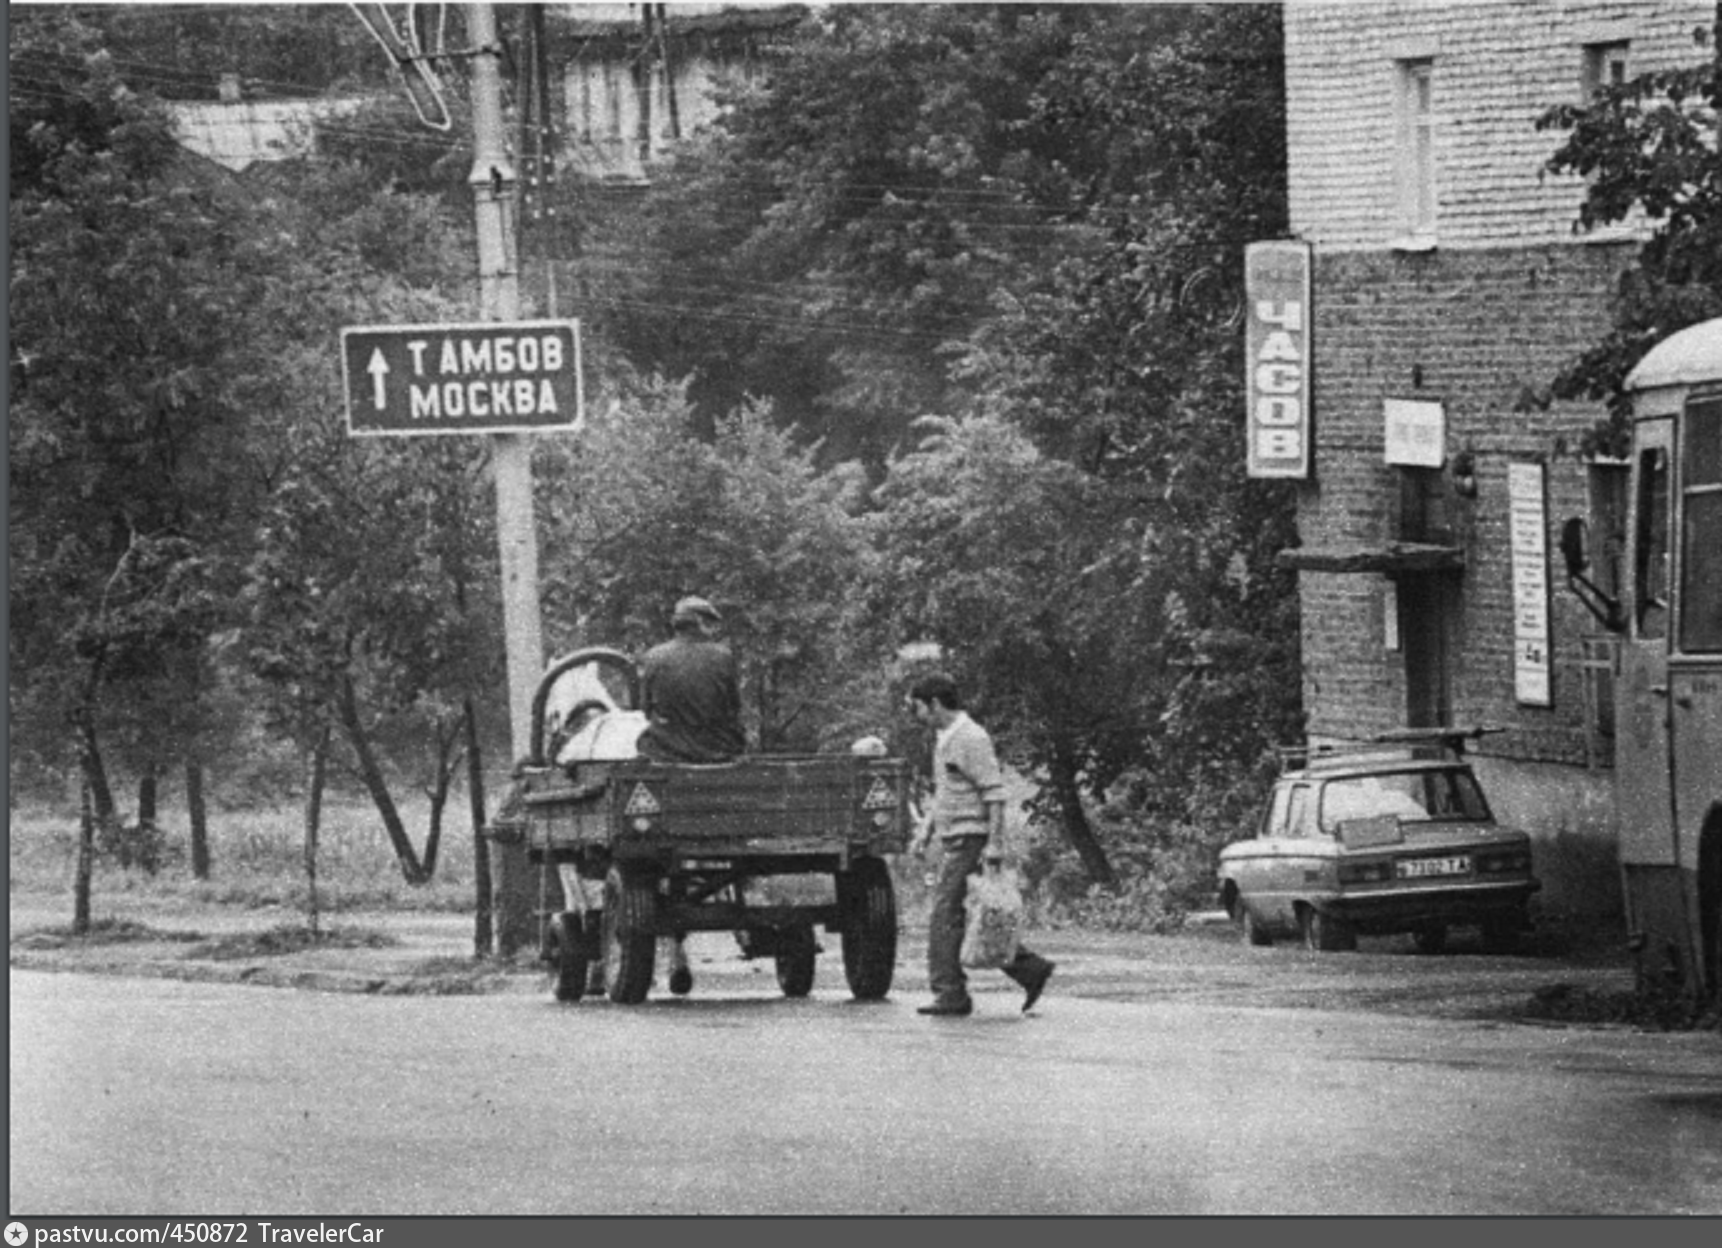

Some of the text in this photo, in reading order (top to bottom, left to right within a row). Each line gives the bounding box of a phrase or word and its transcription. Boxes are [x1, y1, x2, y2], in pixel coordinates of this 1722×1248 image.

[407, 335, 563, 376] ТАМБОВ
[409, 379, 558, 419] МОСКВА
[1255, 302, 1301, 459] ЧАСОВ
